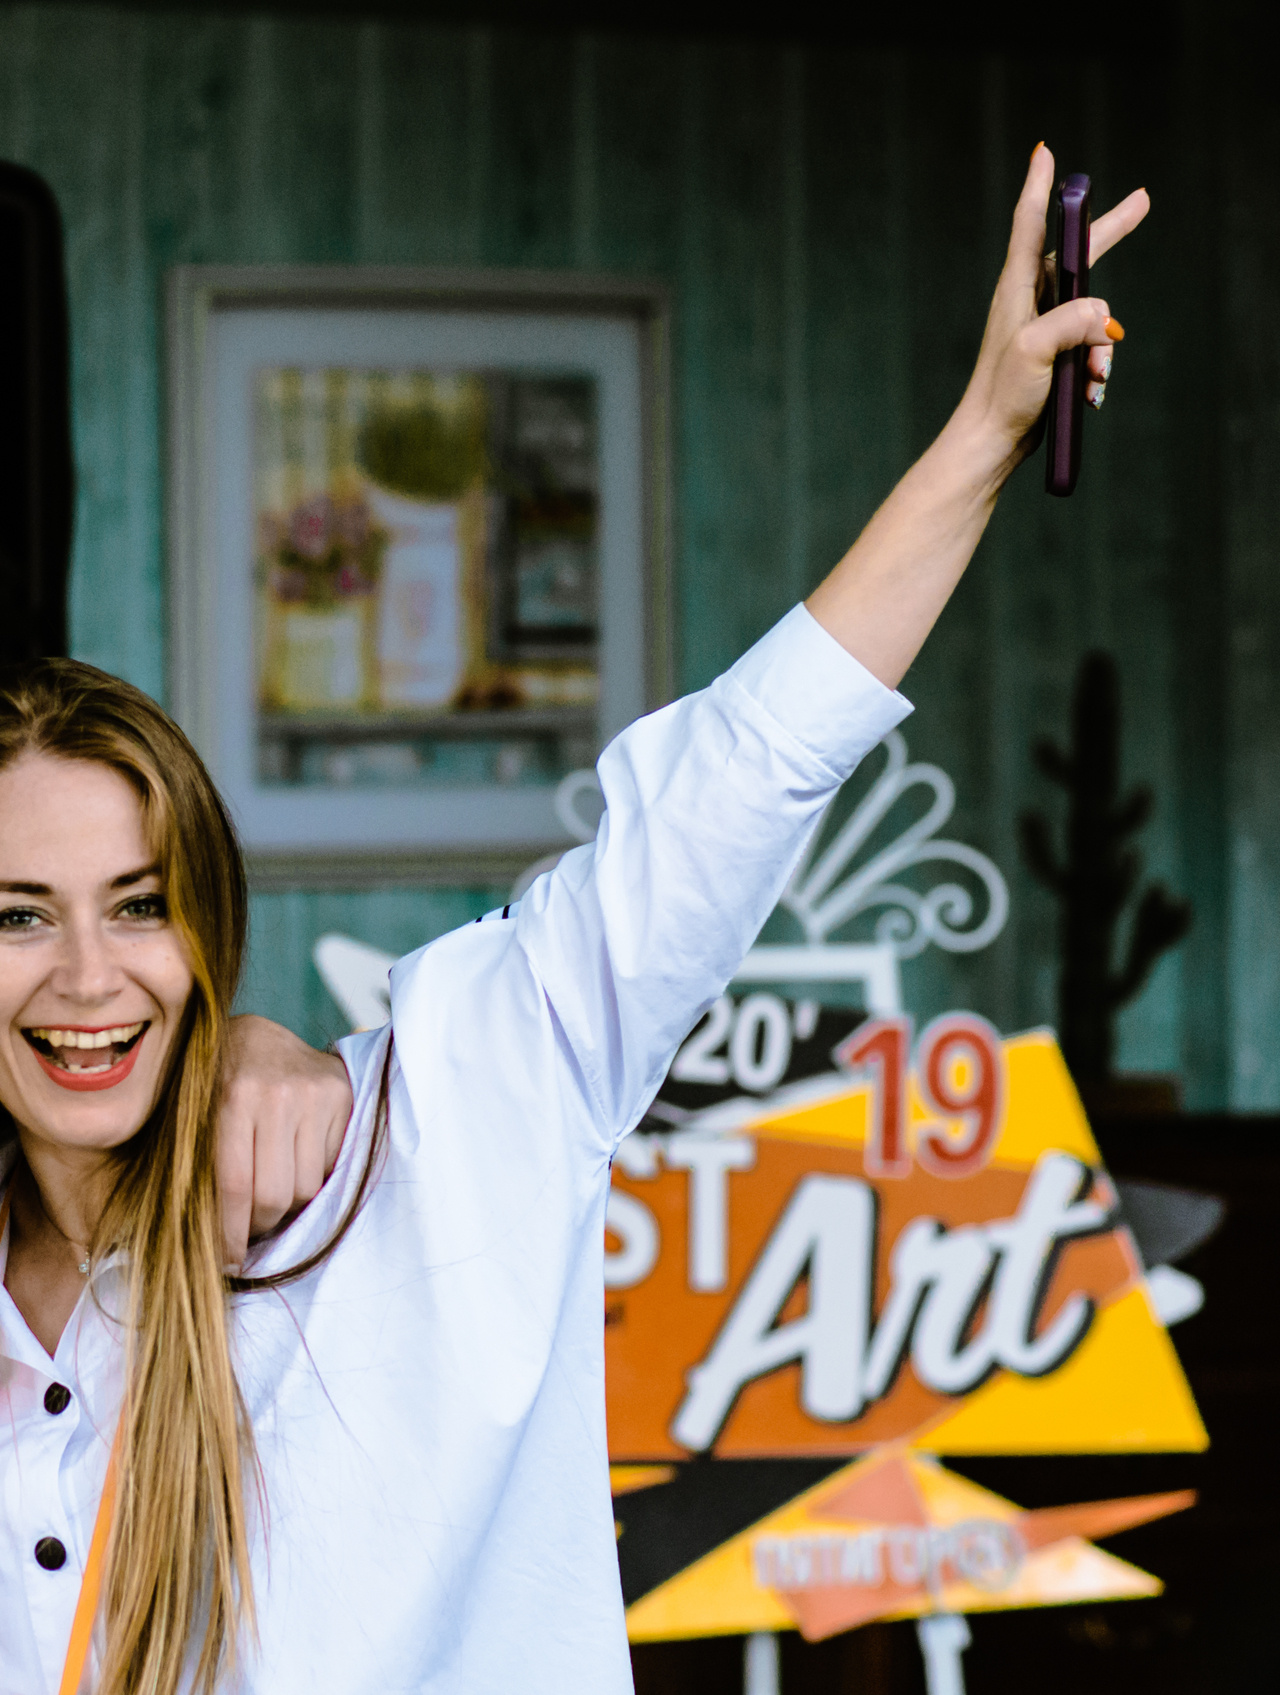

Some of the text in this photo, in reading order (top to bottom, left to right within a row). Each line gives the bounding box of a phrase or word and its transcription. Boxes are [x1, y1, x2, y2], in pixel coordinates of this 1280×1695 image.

[832, 1010, 1007, 1179] 19
[604, 1132, 757, 1294] ST
[668, 1150, 1120, 1454] Art
